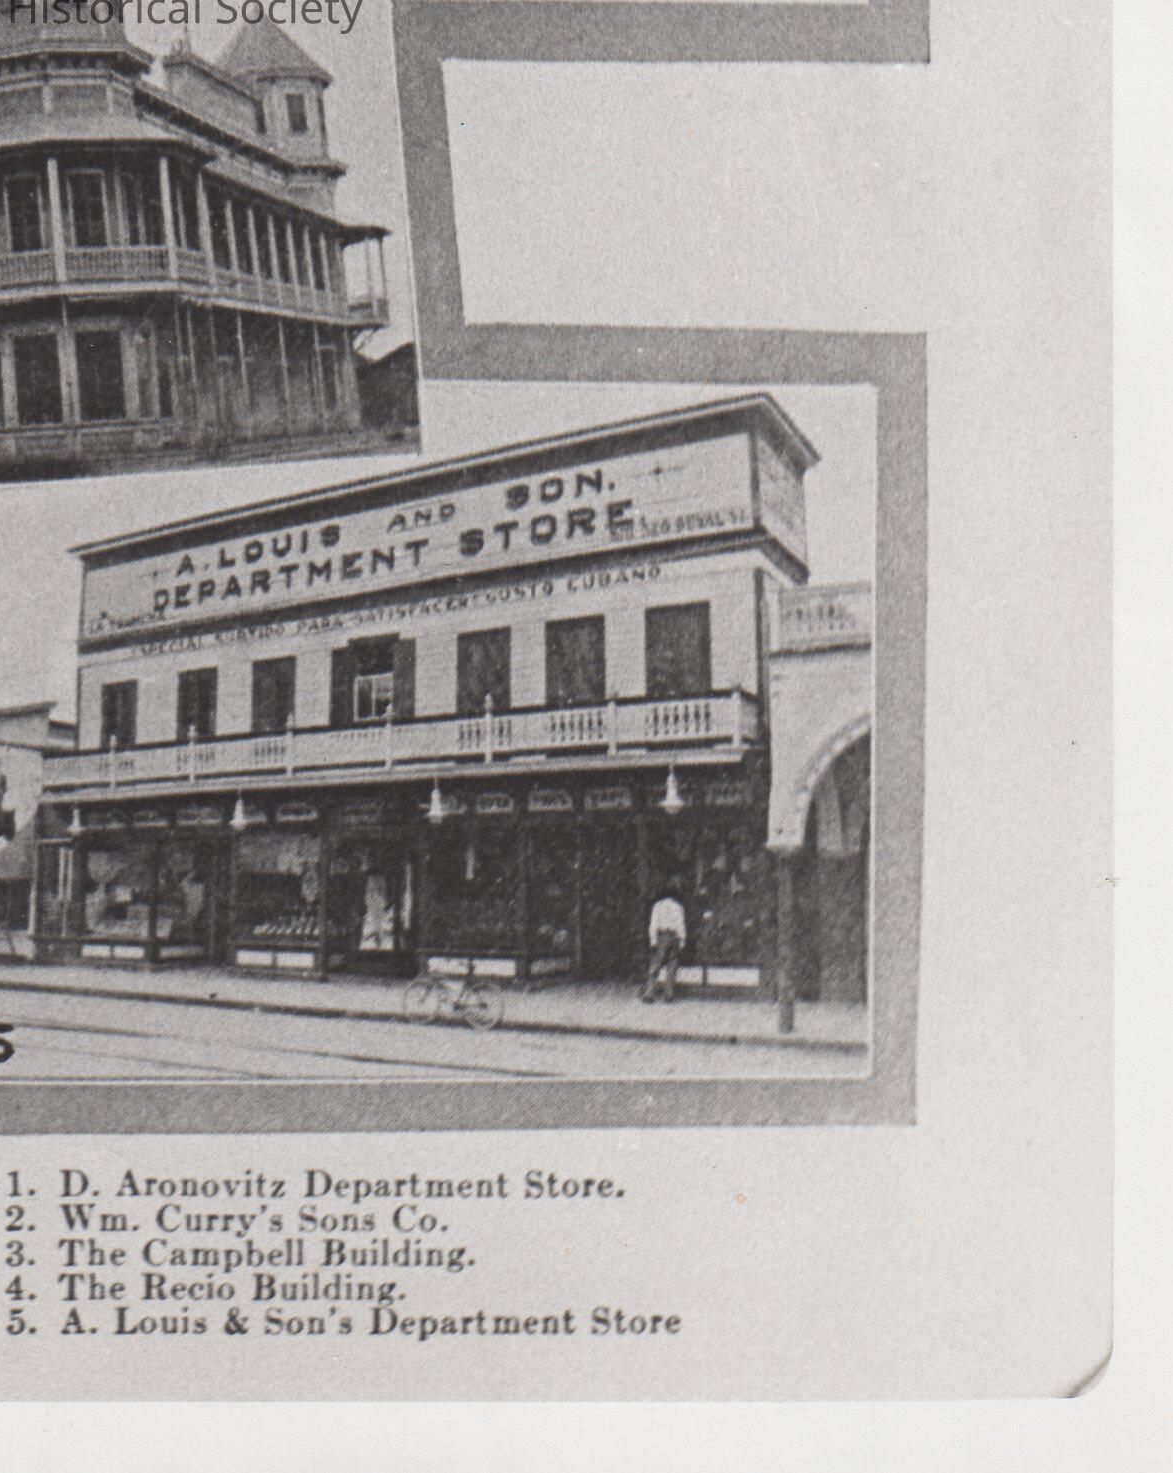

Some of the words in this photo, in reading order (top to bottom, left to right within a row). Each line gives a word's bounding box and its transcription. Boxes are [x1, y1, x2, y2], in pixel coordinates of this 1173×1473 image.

[176, 554, 210, 578] A.
[218, 524, 340, 569] LOUIS
[387, 503, 456, 532] AND
[506, 469, 616, 511] SON.
[153, 538, 429, 615] DEPARTMENT
[460, 499, 632, 557] STORE
[567, 566, 661, 593] CUBANO
[8, 1170, 35, 1197] 1.
[61, 1170, 99, 1197] D.
[117, 1169, 285, 1197] Aronovitz
[305, 1169, 507, 1202] Department
[526, 1170, 624, 1199] Store.
[6, 1204, 35, 1231] 2.
[60, 1203, 139, 1231] Wm.
[156, 1203, 282, 1237] Curry's
[300, 1203, 374, 1231] Sons
[393, 1204, 447, 1232] Co.
[6, 1240, 35, 1267] 3.
[59, 1238, 125, 1266] The
[143, 1237, 303, 1271] Campbell
[322, 1239, 474, 1271] Building.
[6, 1275, 36, 1300] 4.
[58, 1273, 125, 1301] The
[142, 1273, 235, 1300] Recio
[252, 1273, 405, 1305] Building.
[6, 1309, 36, 1335] 5.
[61, 1308, 97, 1335] A.
[115, 1307, 207, 1334] Louis
[224, 1308, 248, 1335] &
[265, 1307, 352, 1334] Son's
[370, 1307, 575, 1341] Department
[592, 1308, 680, 1334] Store
